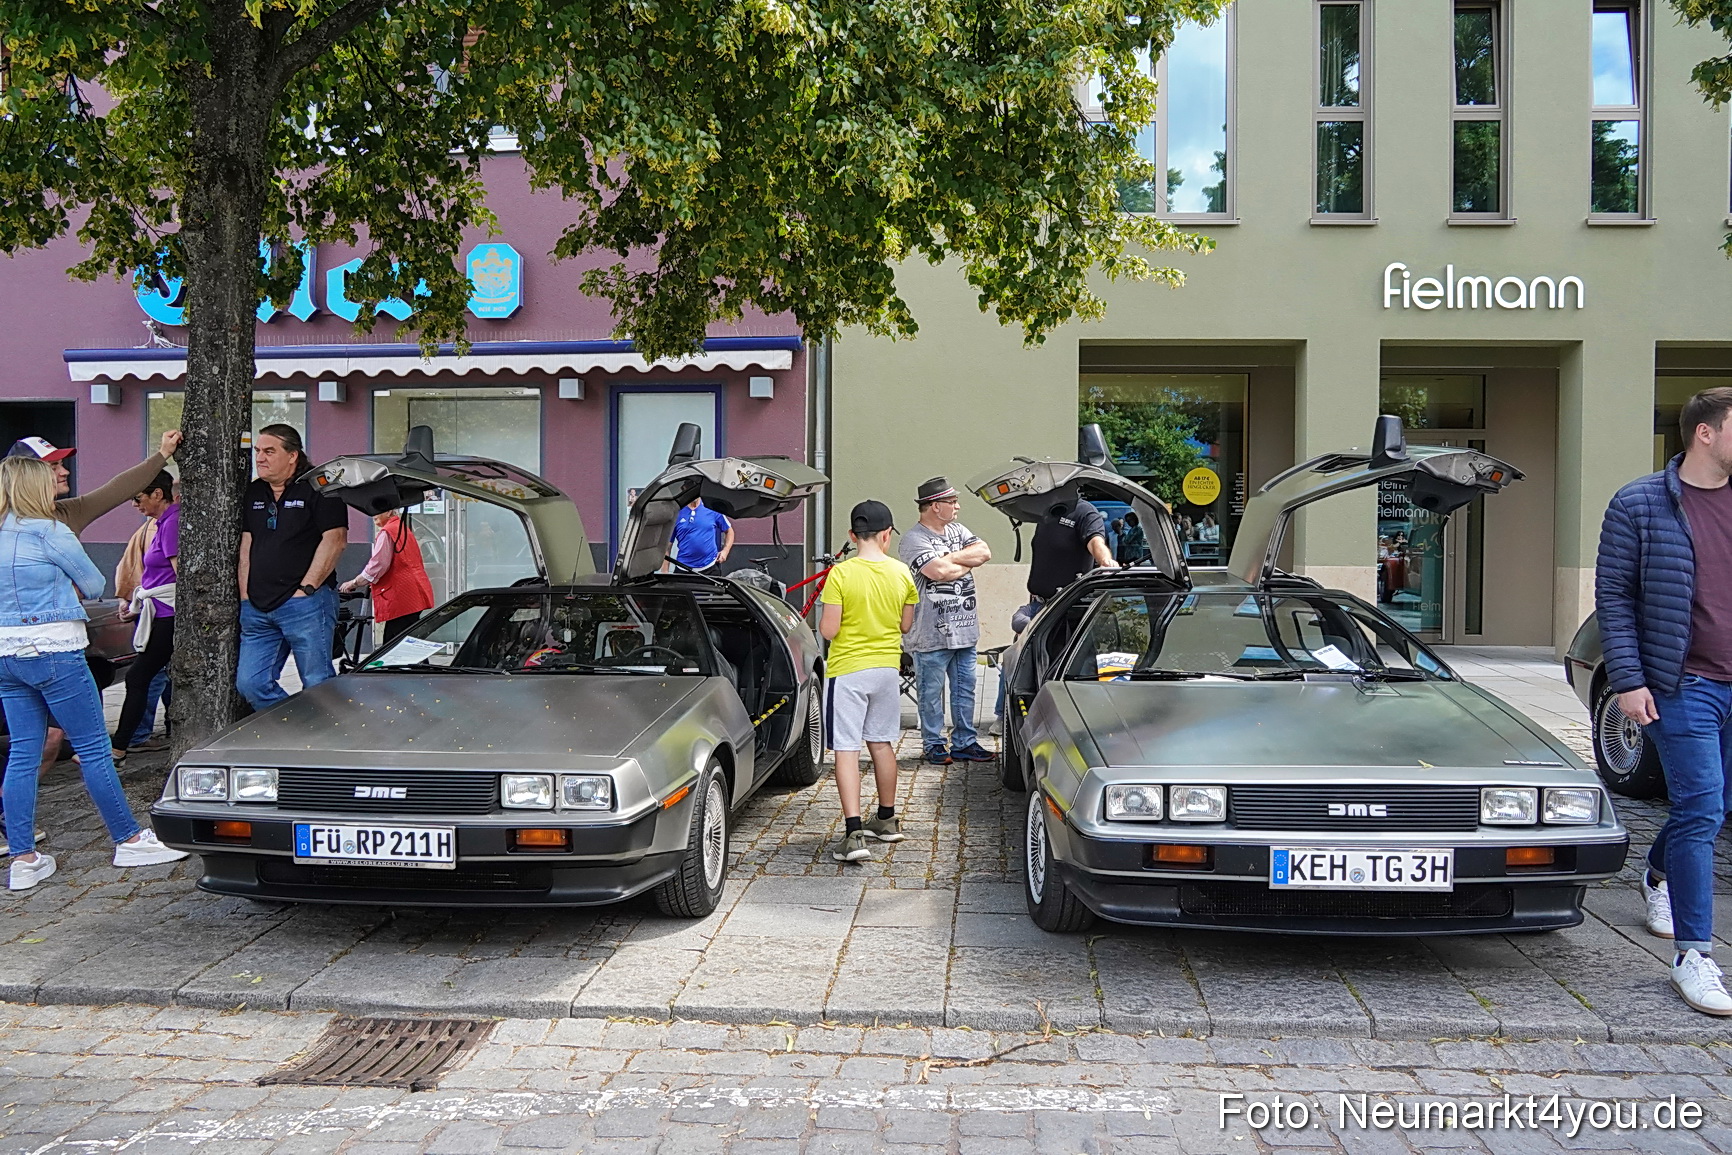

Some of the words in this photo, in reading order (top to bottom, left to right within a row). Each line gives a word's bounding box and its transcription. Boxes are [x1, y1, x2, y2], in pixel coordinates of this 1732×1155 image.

[1384, 262, 1584, 310] fielmann
[300, 842, 308, 851] D
[312, 828, 341, 854] FÜ
[356, 829, 385, 855] RP
[390, 831, 451, 858] 211H
[1276, 870, 1284, 880] D
[1290, 854, 1347, 881] KEH
[1366, 855, 1403, 882] TG
[1410, 855, 1449, 883] 3H
